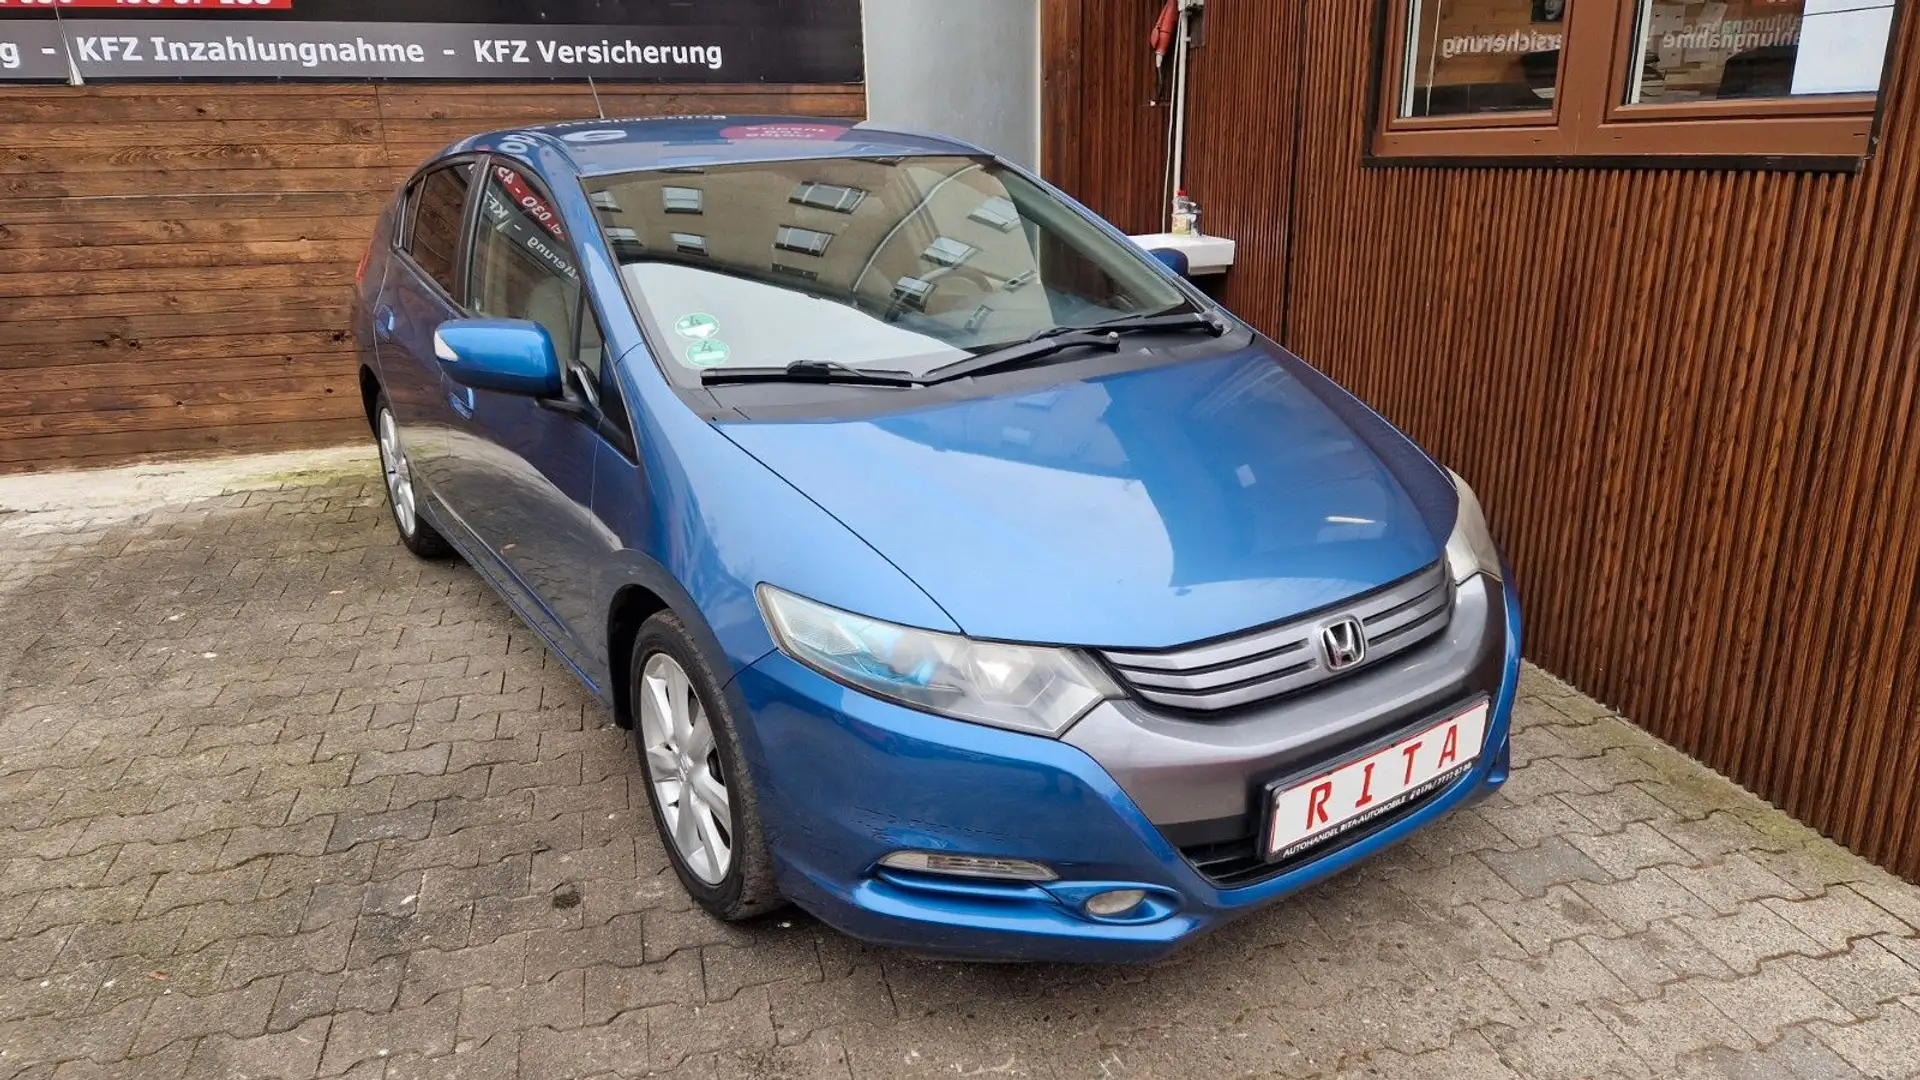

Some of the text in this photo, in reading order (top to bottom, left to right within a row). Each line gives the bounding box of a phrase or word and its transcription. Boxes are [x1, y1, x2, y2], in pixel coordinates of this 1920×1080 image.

[76, 36, 143, 61] KFZ
[151, 36, 425, 68] Inzahlungnahme
[473, 40, 530, 63] KFZ
[536, 40, 722, 69] Versicherung
[1283, 828, 1339, 858] AUTOHANDEL
